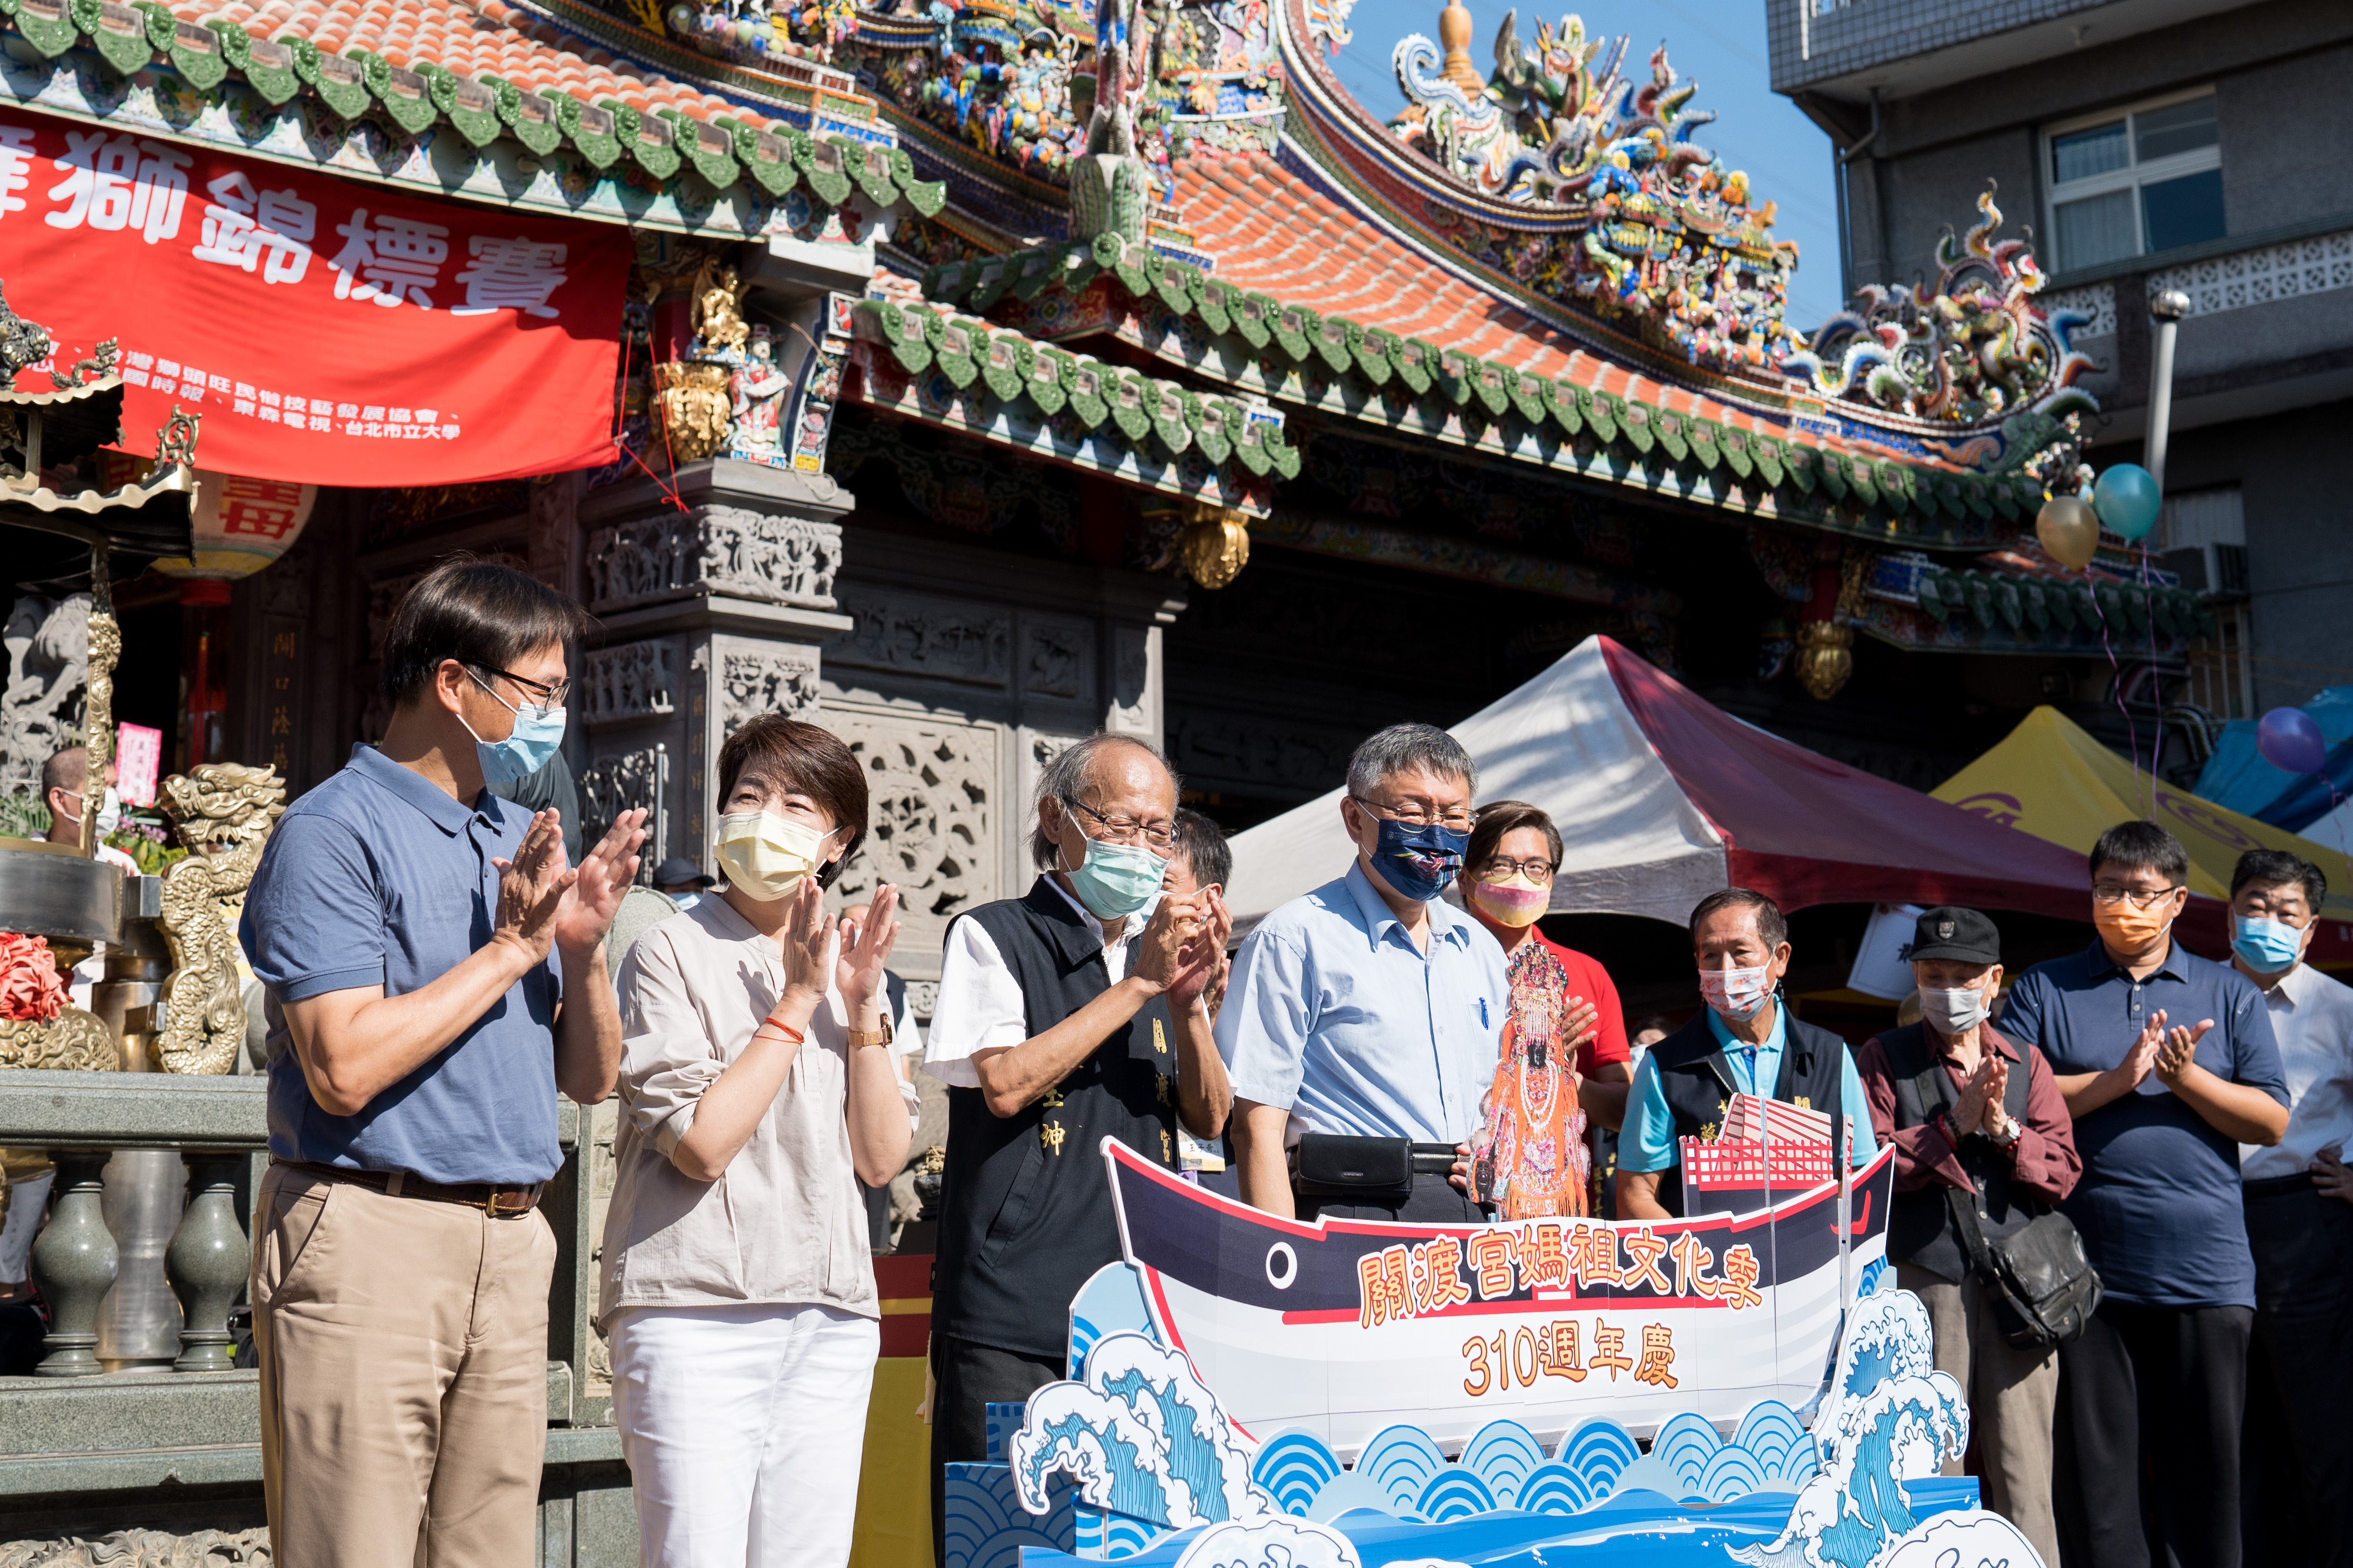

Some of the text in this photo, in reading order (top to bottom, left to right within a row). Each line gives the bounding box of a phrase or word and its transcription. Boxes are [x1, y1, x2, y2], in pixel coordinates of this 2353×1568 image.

[0, 126, 567, 318] 獅錦標賽
[1361, 1224, 1762, 1329] 關渡宮媽祖文化季
[1462, 1318, 1678, 1397] 310週年慶
